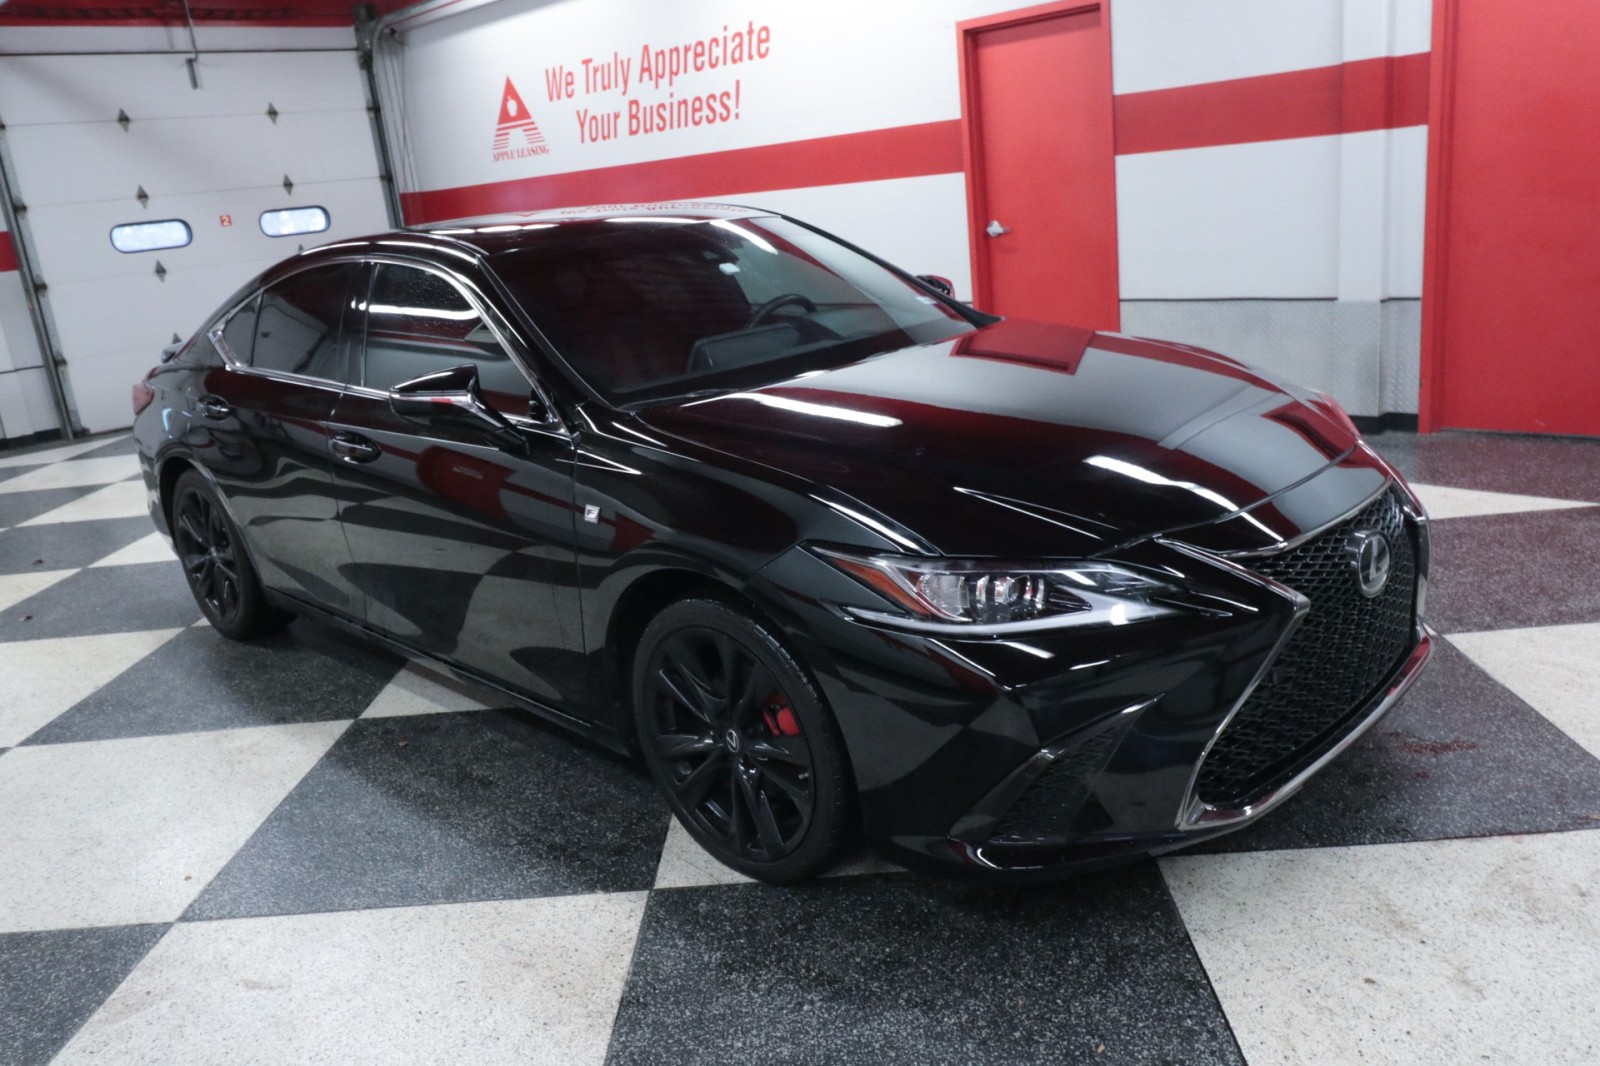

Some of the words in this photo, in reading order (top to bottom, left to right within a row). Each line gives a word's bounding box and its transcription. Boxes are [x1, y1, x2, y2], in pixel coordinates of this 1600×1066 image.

[545, 65, 575, 102] We
[581, 51, 631, 96] Truly
[639, 21, 771, 89] Appreciate
[576, 108, 620, 144] Your
[628, 79, 741, 137] Business!
[492, 150, 516, 162] APPLE
[517, 145, 550, 160] LEASING
[220, 215, 231, 226] 2
